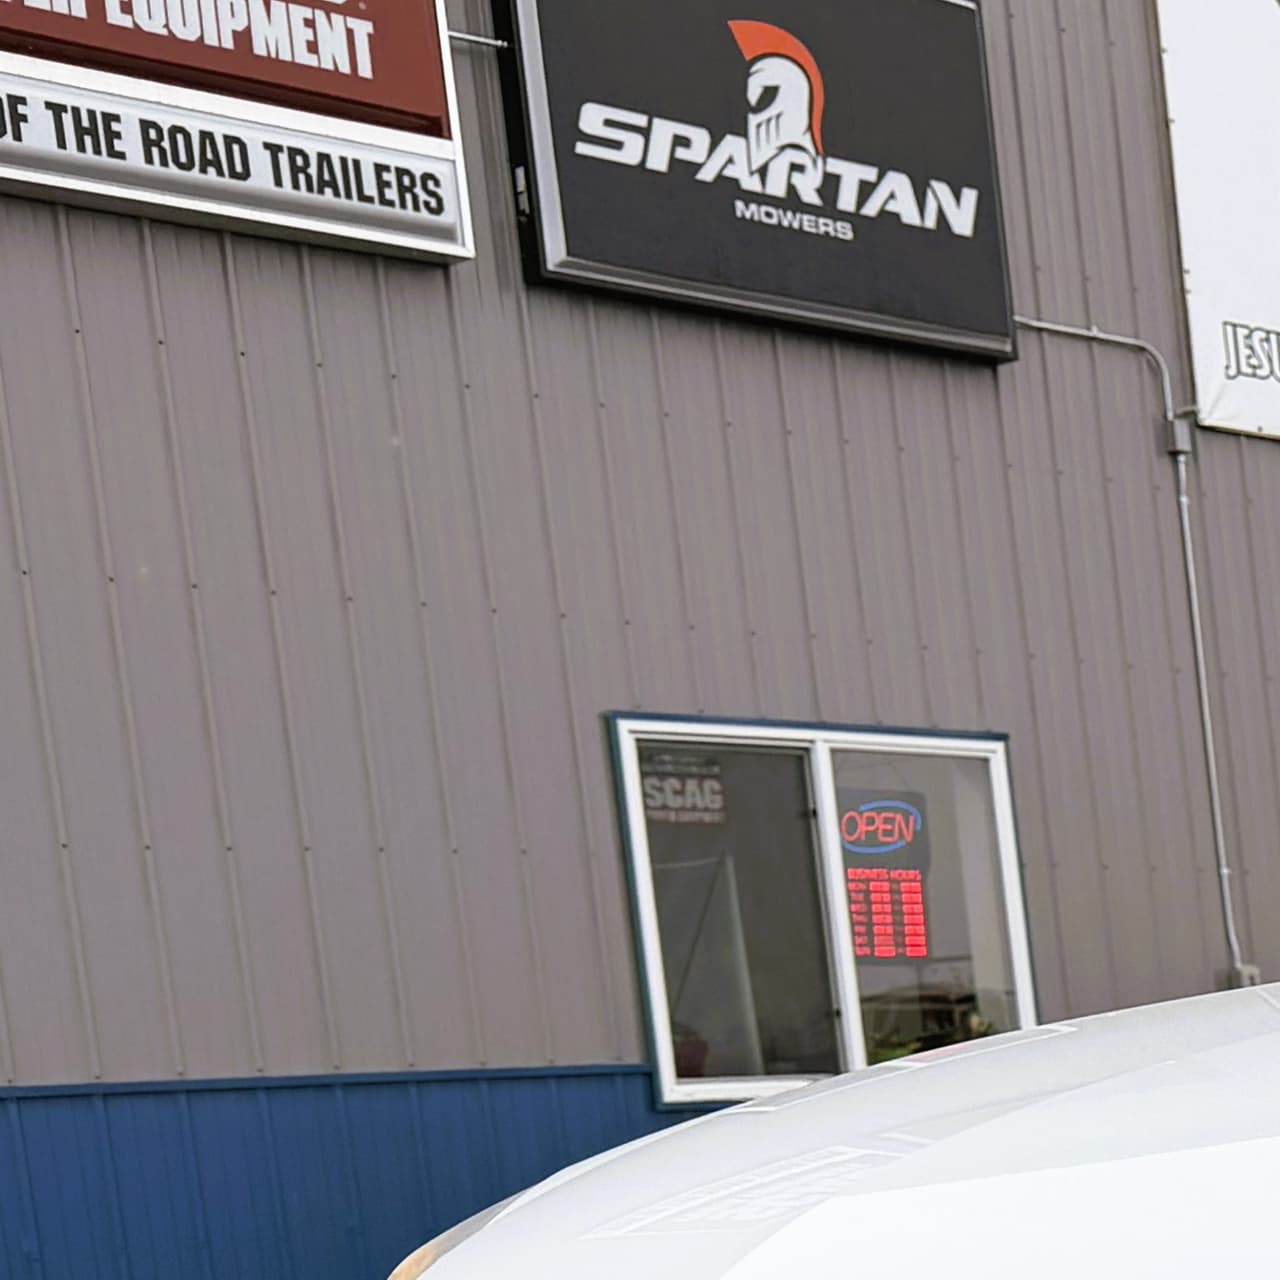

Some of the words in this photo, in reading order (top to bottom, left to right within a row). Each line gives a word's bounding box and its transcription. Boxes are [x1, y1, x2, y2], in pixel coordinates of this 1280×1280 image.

[0, 93, 28, 143] F
[44, 100, 127, 161] THE
[138, 117, 250, 182] ROAD
[262, 141, 445, 216] TRAILERS
[574, 101, 979, 239] SPARTAN
[734, 199, 855, 241] MOWERS
[643, 777, 724, 809] SCAG
[840, 810, 916, 843] OPEN
